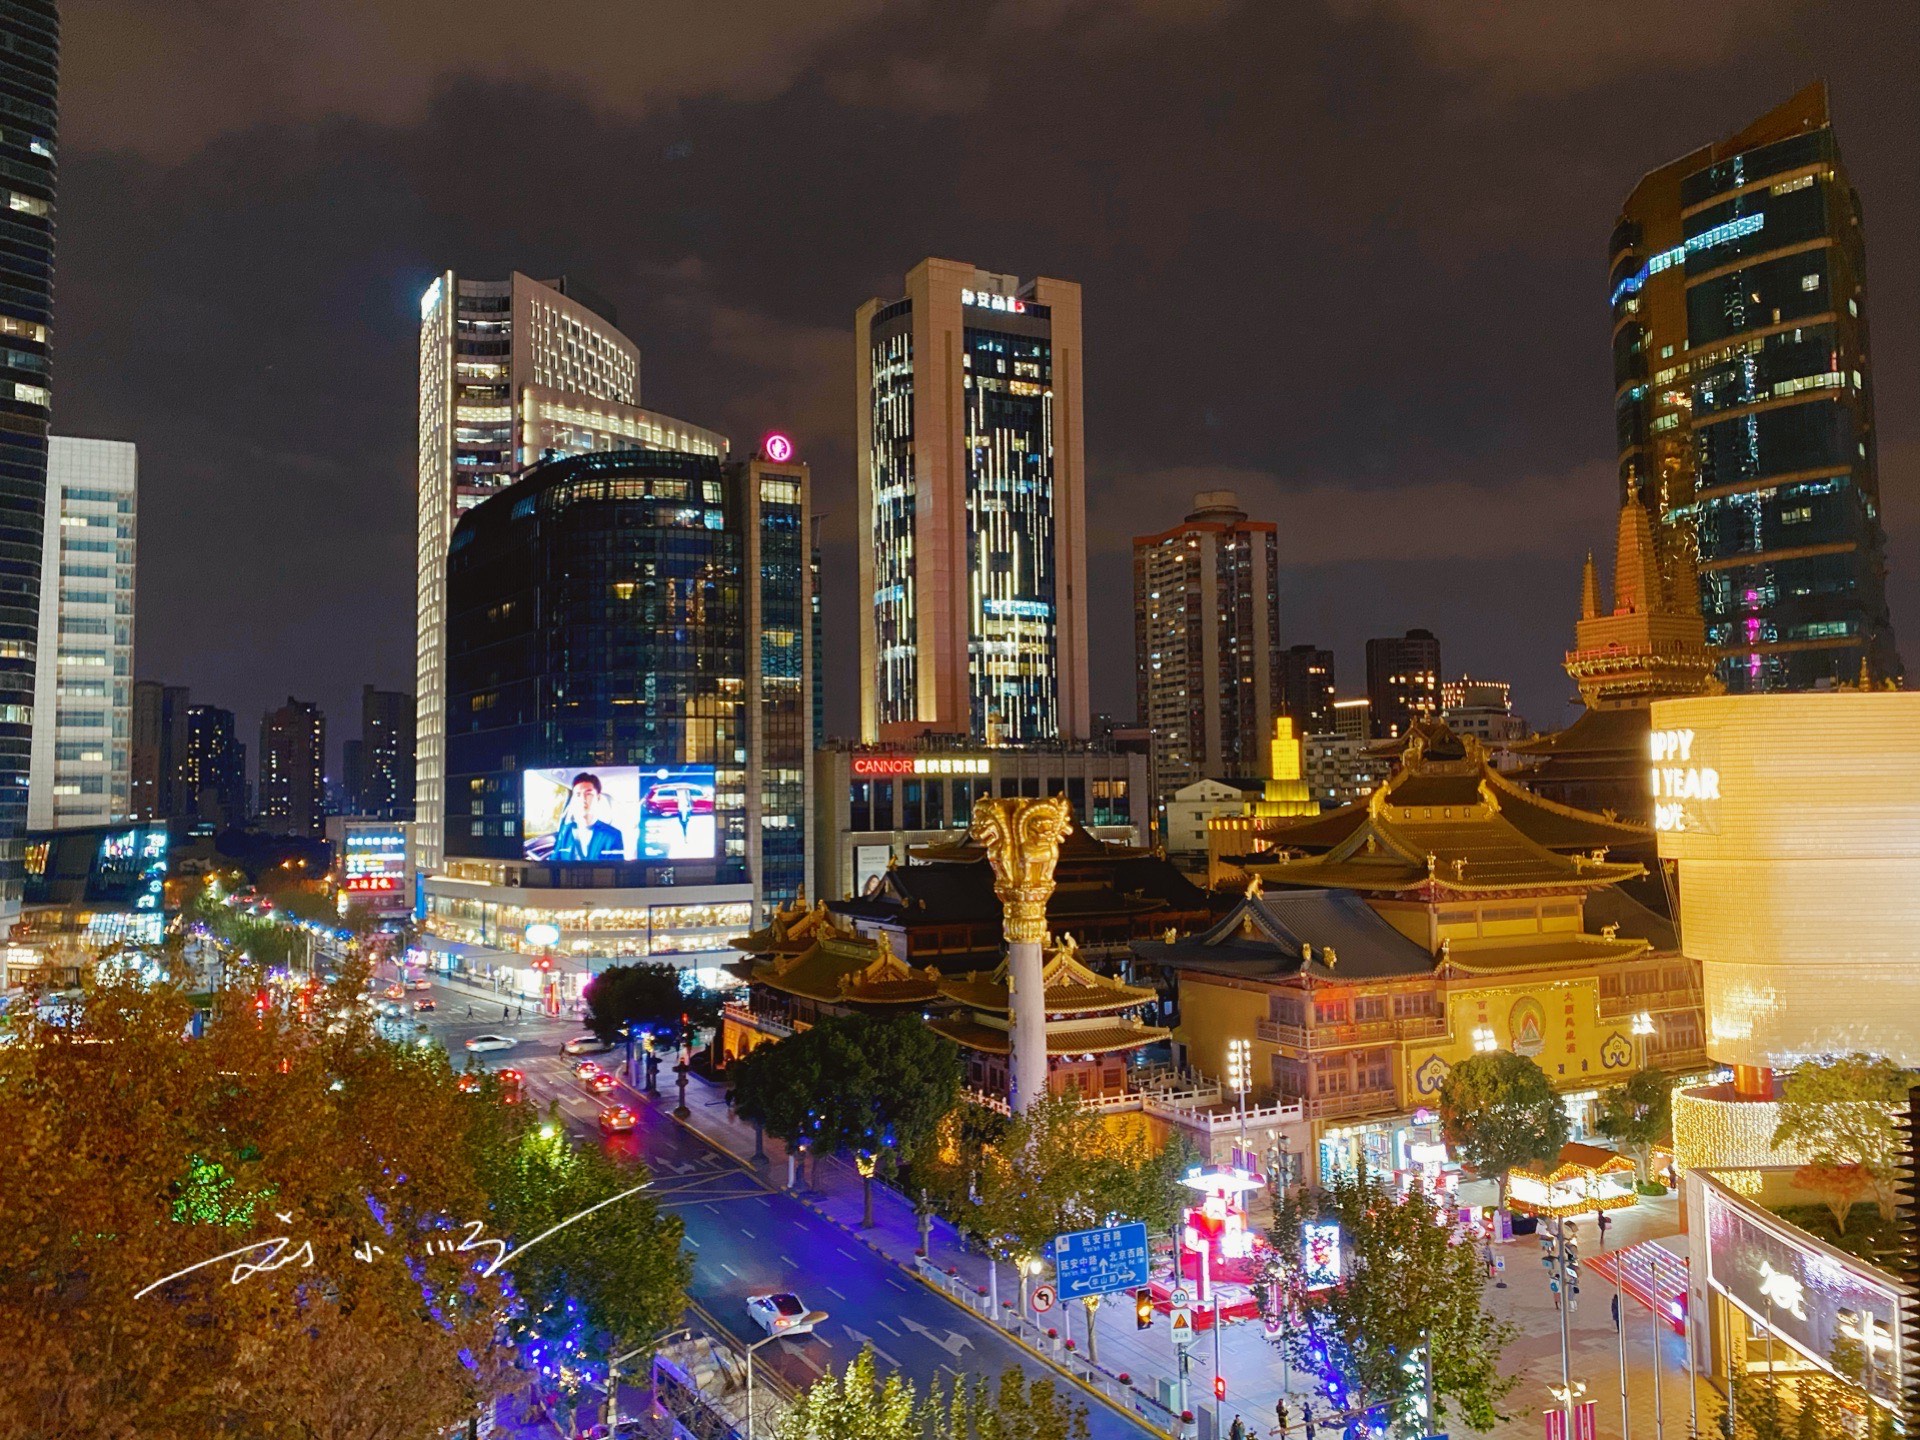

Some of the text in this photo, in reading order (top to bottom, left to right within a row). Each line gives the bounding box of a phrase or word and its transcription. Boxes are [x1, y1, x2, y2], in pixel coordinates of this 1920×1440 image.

[855, 760, 912, 773] CANNOR
[1663, 768, 1721, 799] YEAR
[1081, 1231, 1122, 1247] 延安西路
[1109, 1247, 1145, 1262] 北京西路
[1060, 1255, 1098, 1271] 延安中路
[1091, 1275, 1117, 1286] 华山路
[1173, 1293, 1186, 1304] 30
